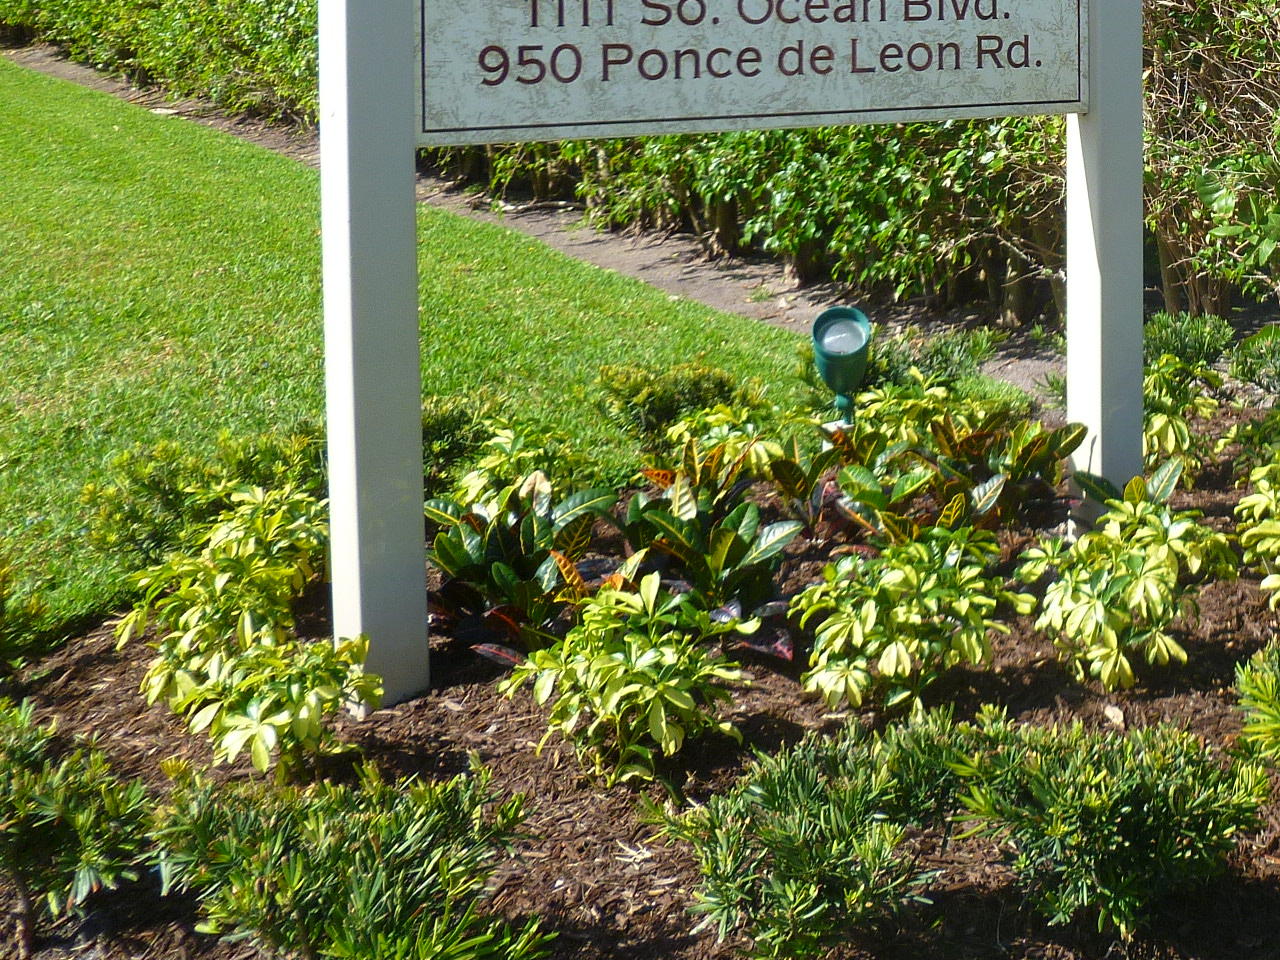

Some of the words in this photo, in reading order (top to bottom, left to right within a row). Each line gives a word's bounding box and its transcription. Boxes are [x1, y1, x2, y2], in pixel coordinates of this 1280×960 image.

[477, 43, 583, 87] 950
[601, 42, 763, 83] Ponce
[776, 39, 837, 77] de
[850, 37, 965, 75] Leon
[976, 34, 1043, 70] Rd.
